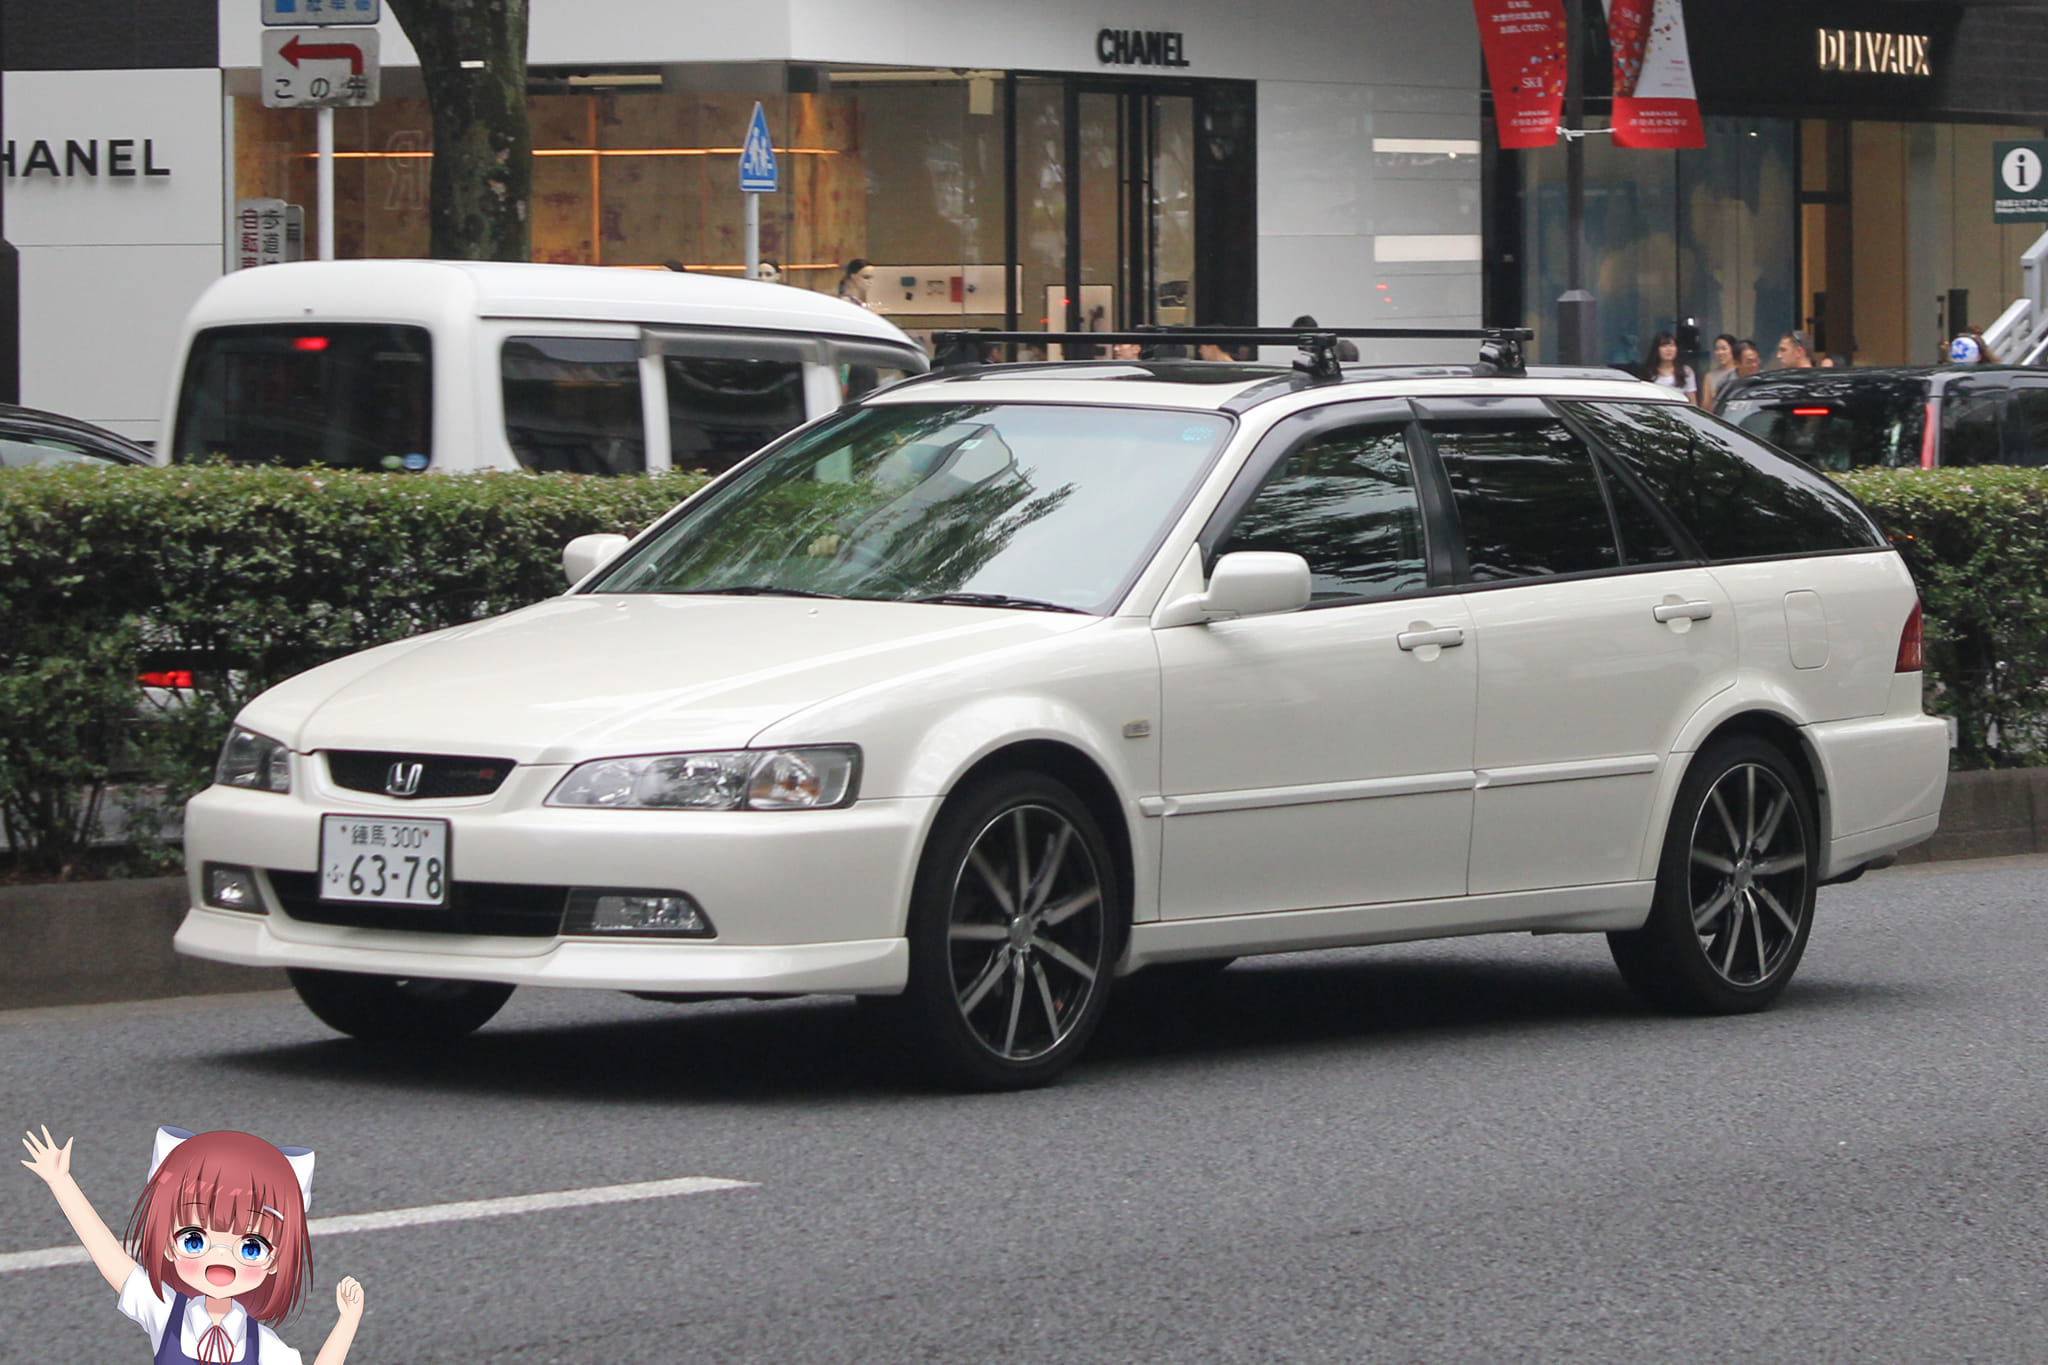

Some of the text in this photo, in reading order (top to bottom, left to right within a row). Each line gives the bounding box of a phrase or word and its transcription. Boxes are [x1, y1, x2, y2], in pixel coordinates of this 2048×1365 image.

[1097, 29, 1190, 67] CHANEL
[274, 75, 368, 100] この先
[351, 824, 424, 849] 練馬 300
[349, 854, 443, 899] 63-78
